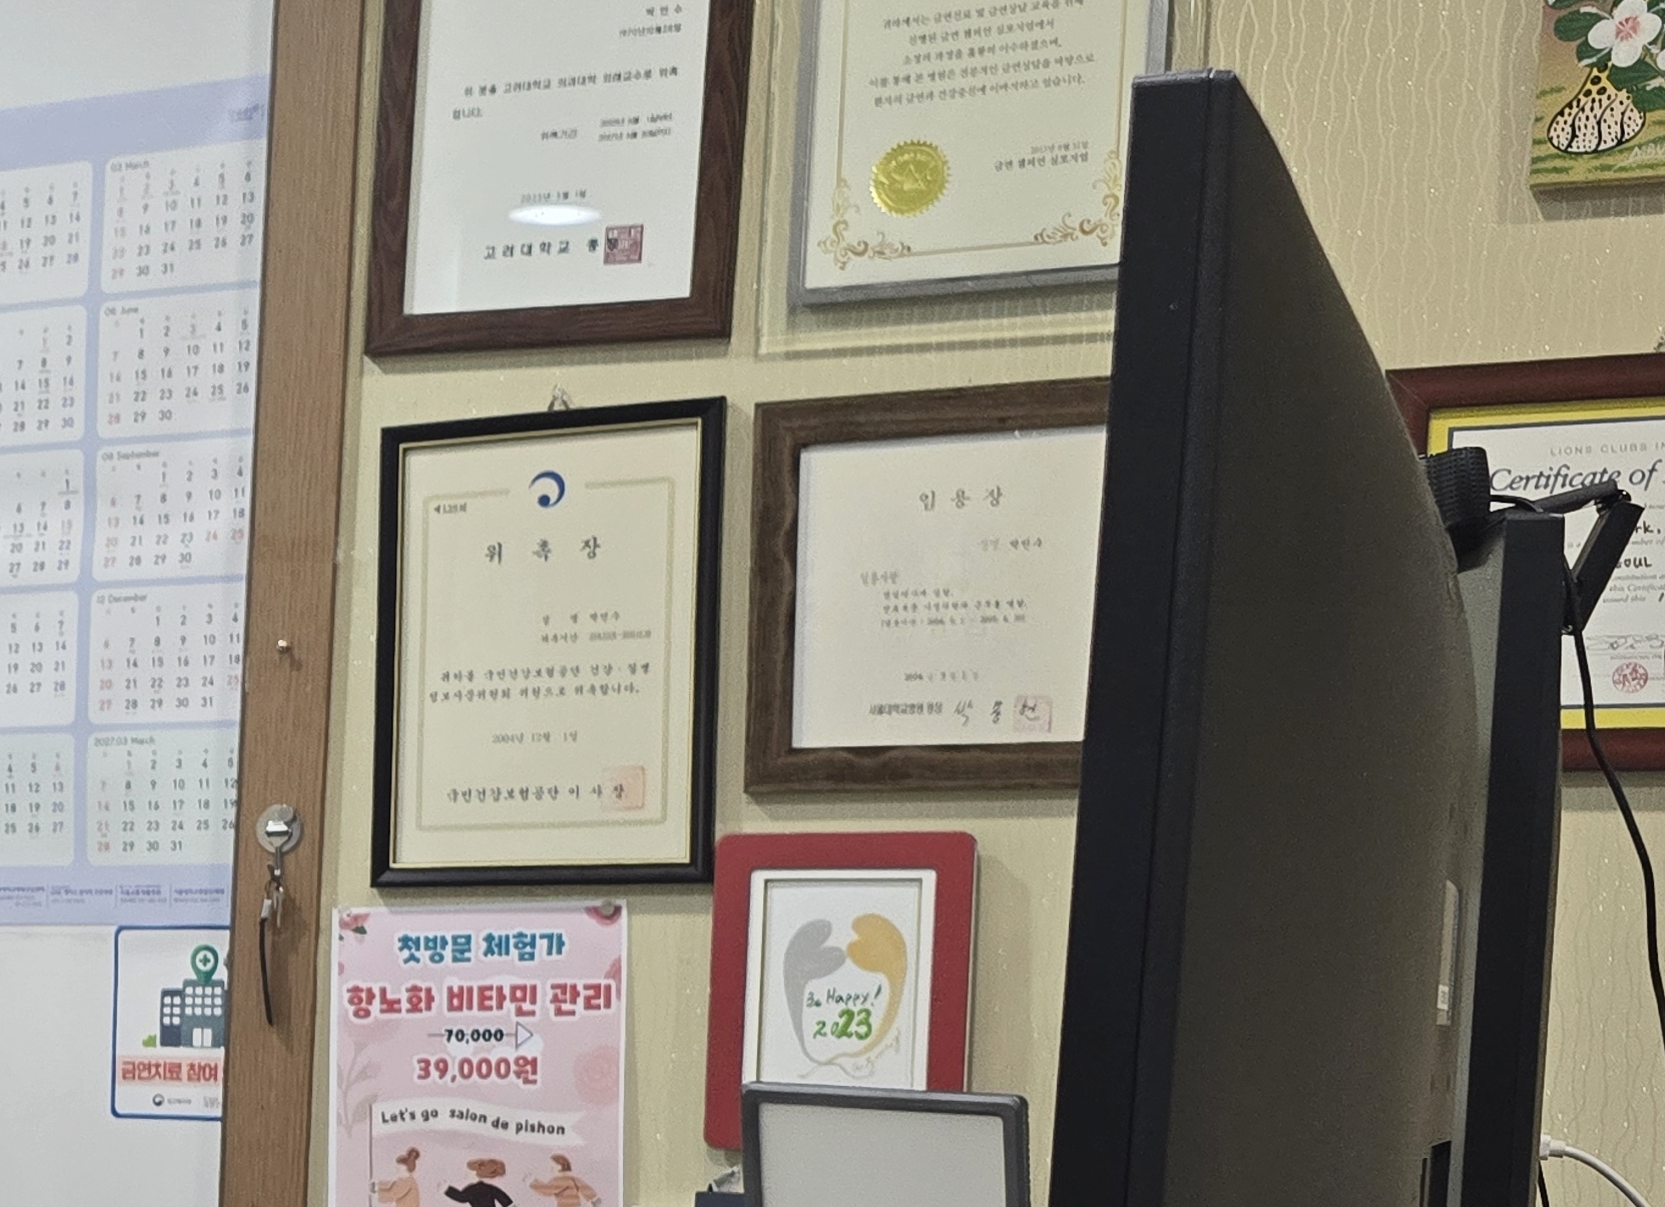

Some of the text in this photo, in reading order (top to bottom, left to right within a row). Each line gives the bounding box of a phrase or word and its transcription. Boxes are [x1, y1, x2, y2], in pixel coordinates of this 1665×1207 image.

[1550, 445, 1592, 457] LIONS
[1601, 442, 1647, 454] CLUBS
[1490, 459, 1663, 494] Certificate of
[156, 612, 213, 627] 1 2 3
[203, 632, 239, 646] 10 11
[126, 654, 215, 670] 14 16 17
[125, 675, 214, 691] 21 23 24
[125, 696, 213, 711] 28 29 30 31
[151, 758, 208, 771] 2 3 4
[150, 777, 210, 791] 9 10 11
[123, 798, 210, 813] 15 16 17 18
[122, 819, 210, 832] 22 23 24 25
[122, 840, 182, 853] 29 30 31
[397, 931, 566, 965] 첫방문 체험가
[346, 981, 613, 1019] 항노화 비타민 관리
[826, 984, 882, 1008] Happy!
[444, 1028, 505, 1045] 70,000
[122, 1061, 218, 1082] 금연치료 참여
[417, 1055, 539, 1085] 39,000원
[381, 1107, 566, 1135] Let's go salon de pishon
